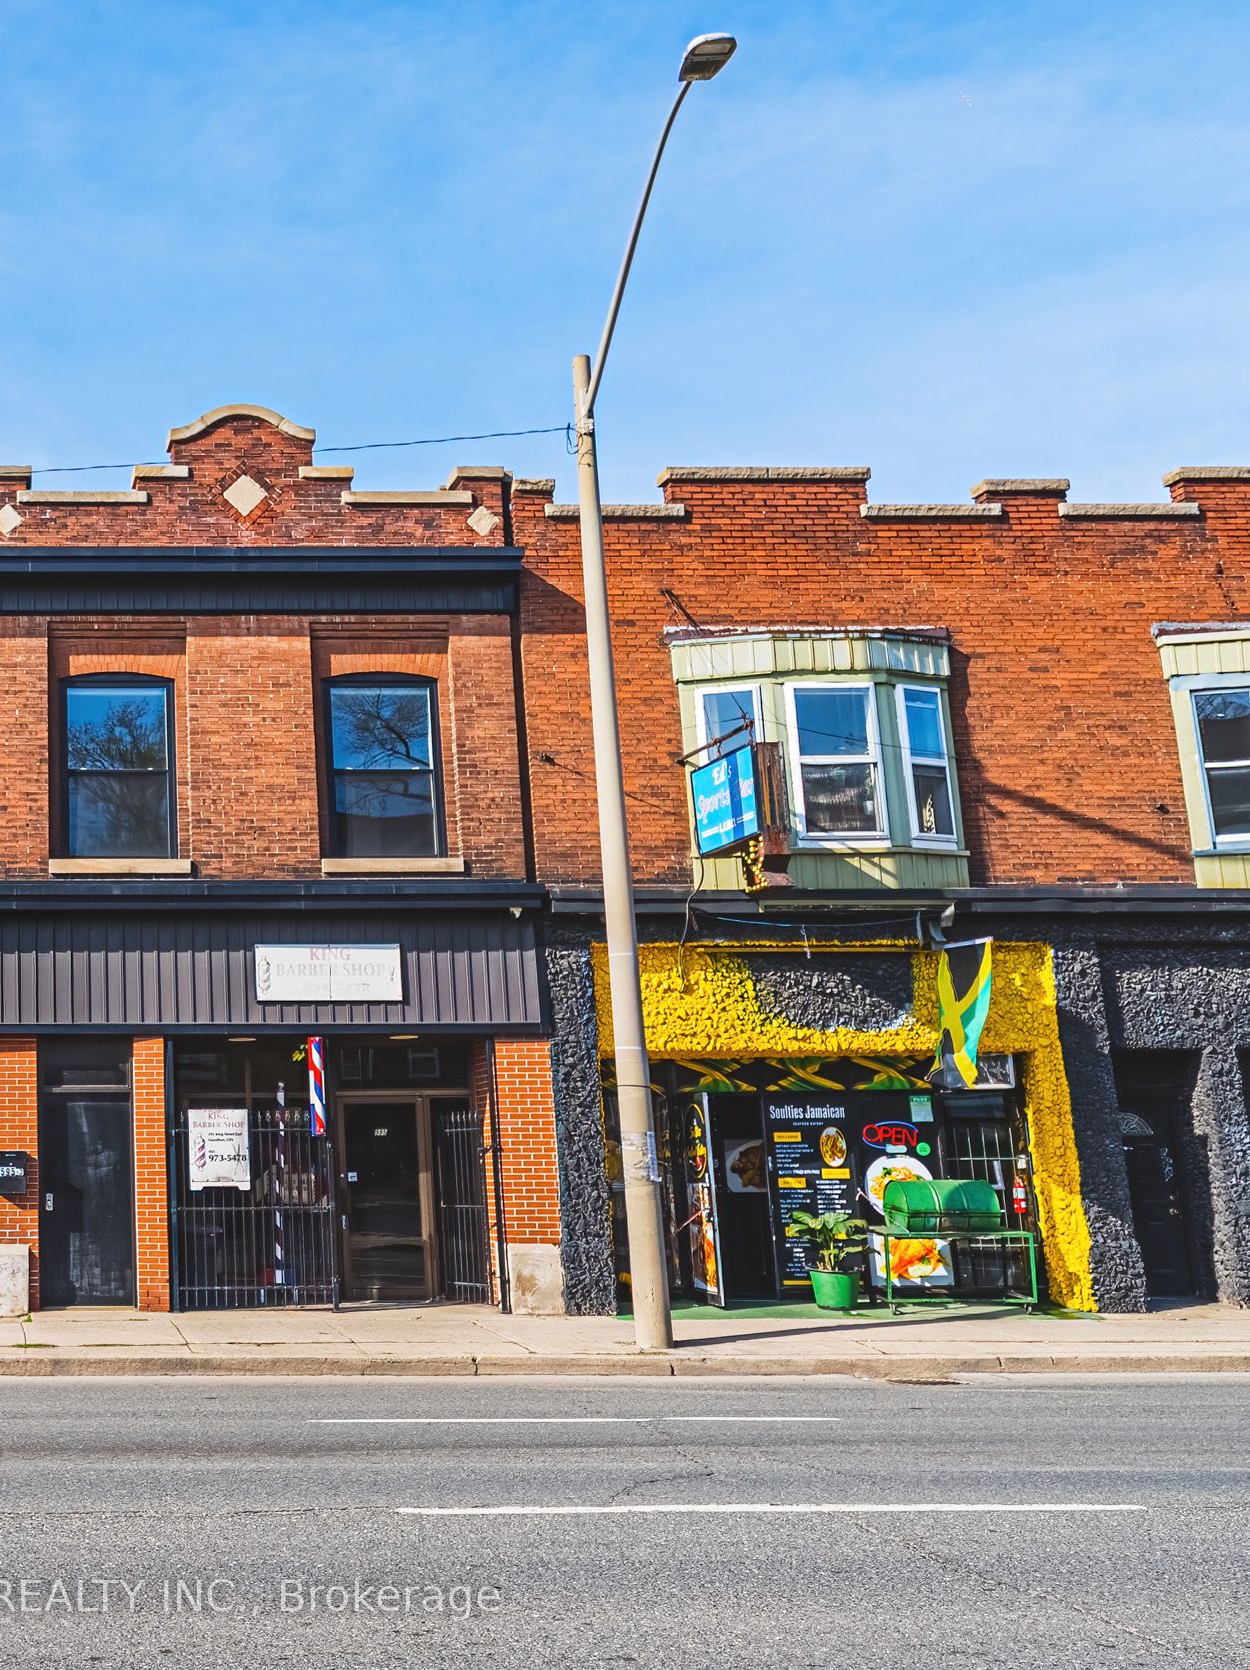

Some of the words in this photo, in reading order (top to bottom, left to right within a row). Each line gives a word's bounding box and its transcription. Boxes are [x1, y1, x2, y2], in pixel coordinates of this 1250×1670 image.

[696, 788, 731, 825] Sports
[309, 948, 351, 961] KING
[276, 963, 338, 977] BARBER
[342, 963, 386, 977] SHOP
[208, 1112, 229, 1120] KING
[770, 1104, 804, 1119] Soulties
[805, 1104, 846, 1119] Jamaican
[193, 1121, 222, 1129] BARBER
[224, 1121, 246, 1129] SHOP
[863, 1124, 918, 1148] OPEN
[208, 1154, 247, 1162] 973-5478
